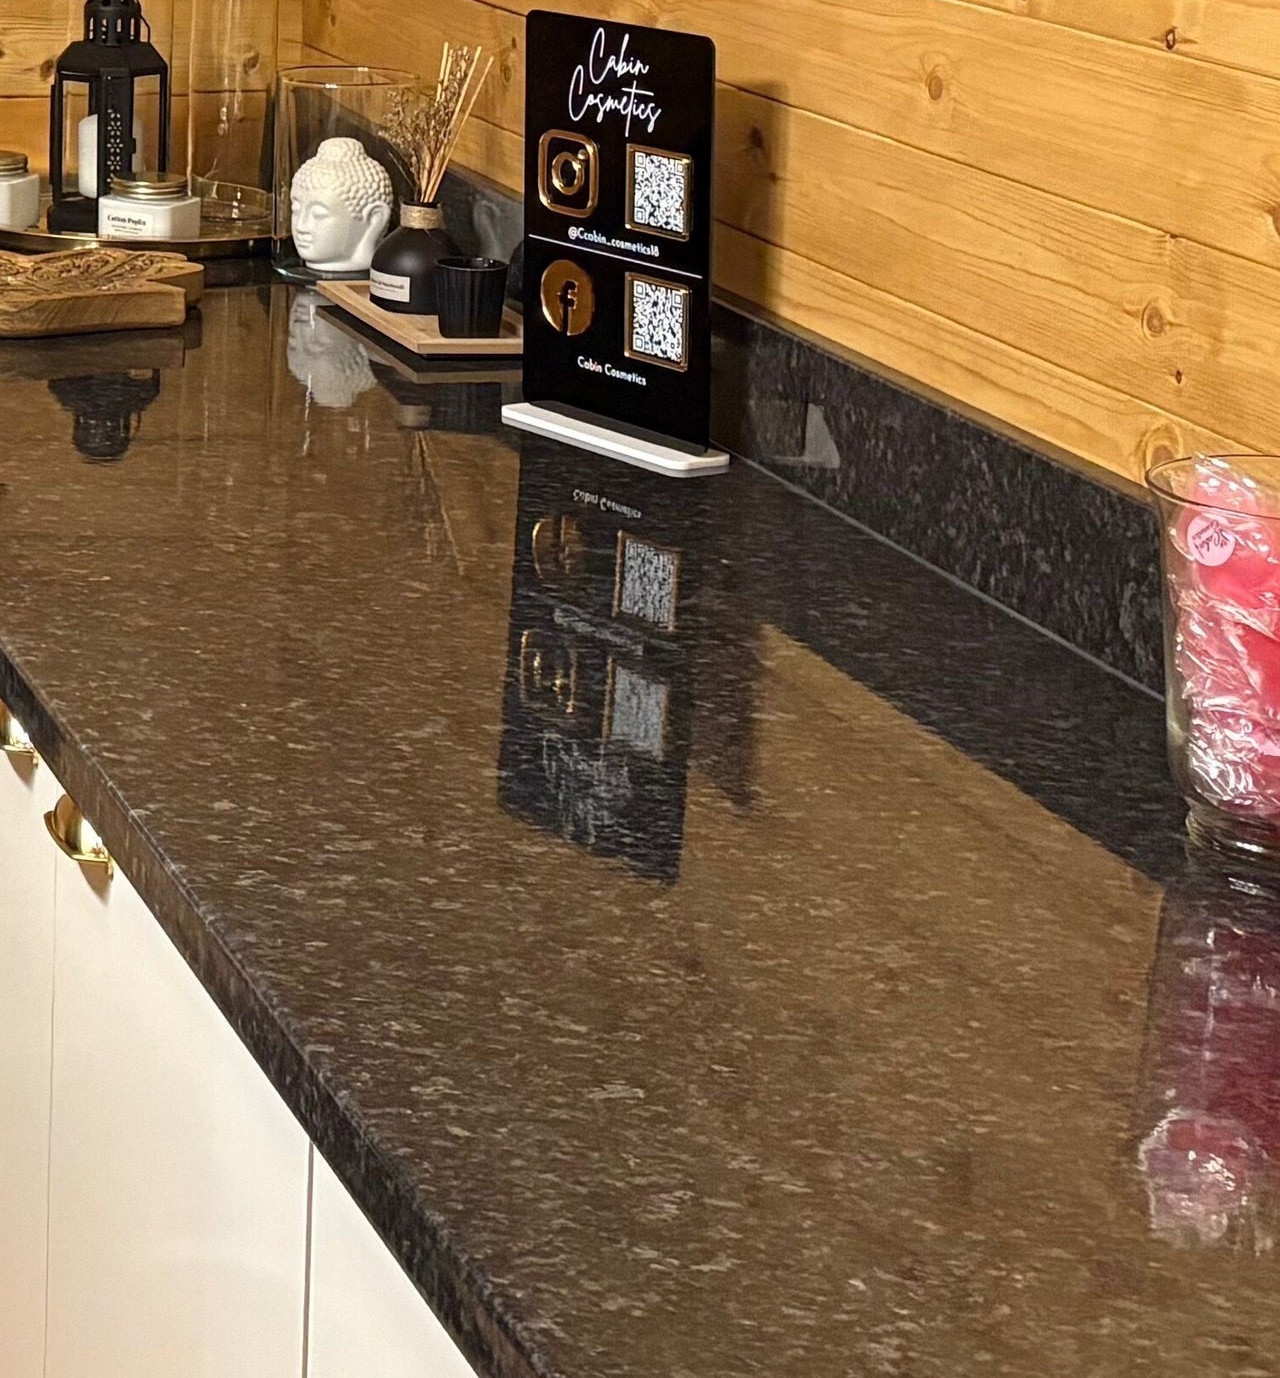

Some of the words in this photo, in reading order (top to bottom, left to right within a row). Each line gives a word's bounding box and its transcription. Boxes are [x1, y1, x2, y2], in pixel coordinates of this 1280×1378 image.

[589, 27, 649, 84] Cabin
[568, 64, 662, 137] Cosmetics
[577, 355, 603, 373] Cabin
[604, 363, 647, 386] Cosmetics
